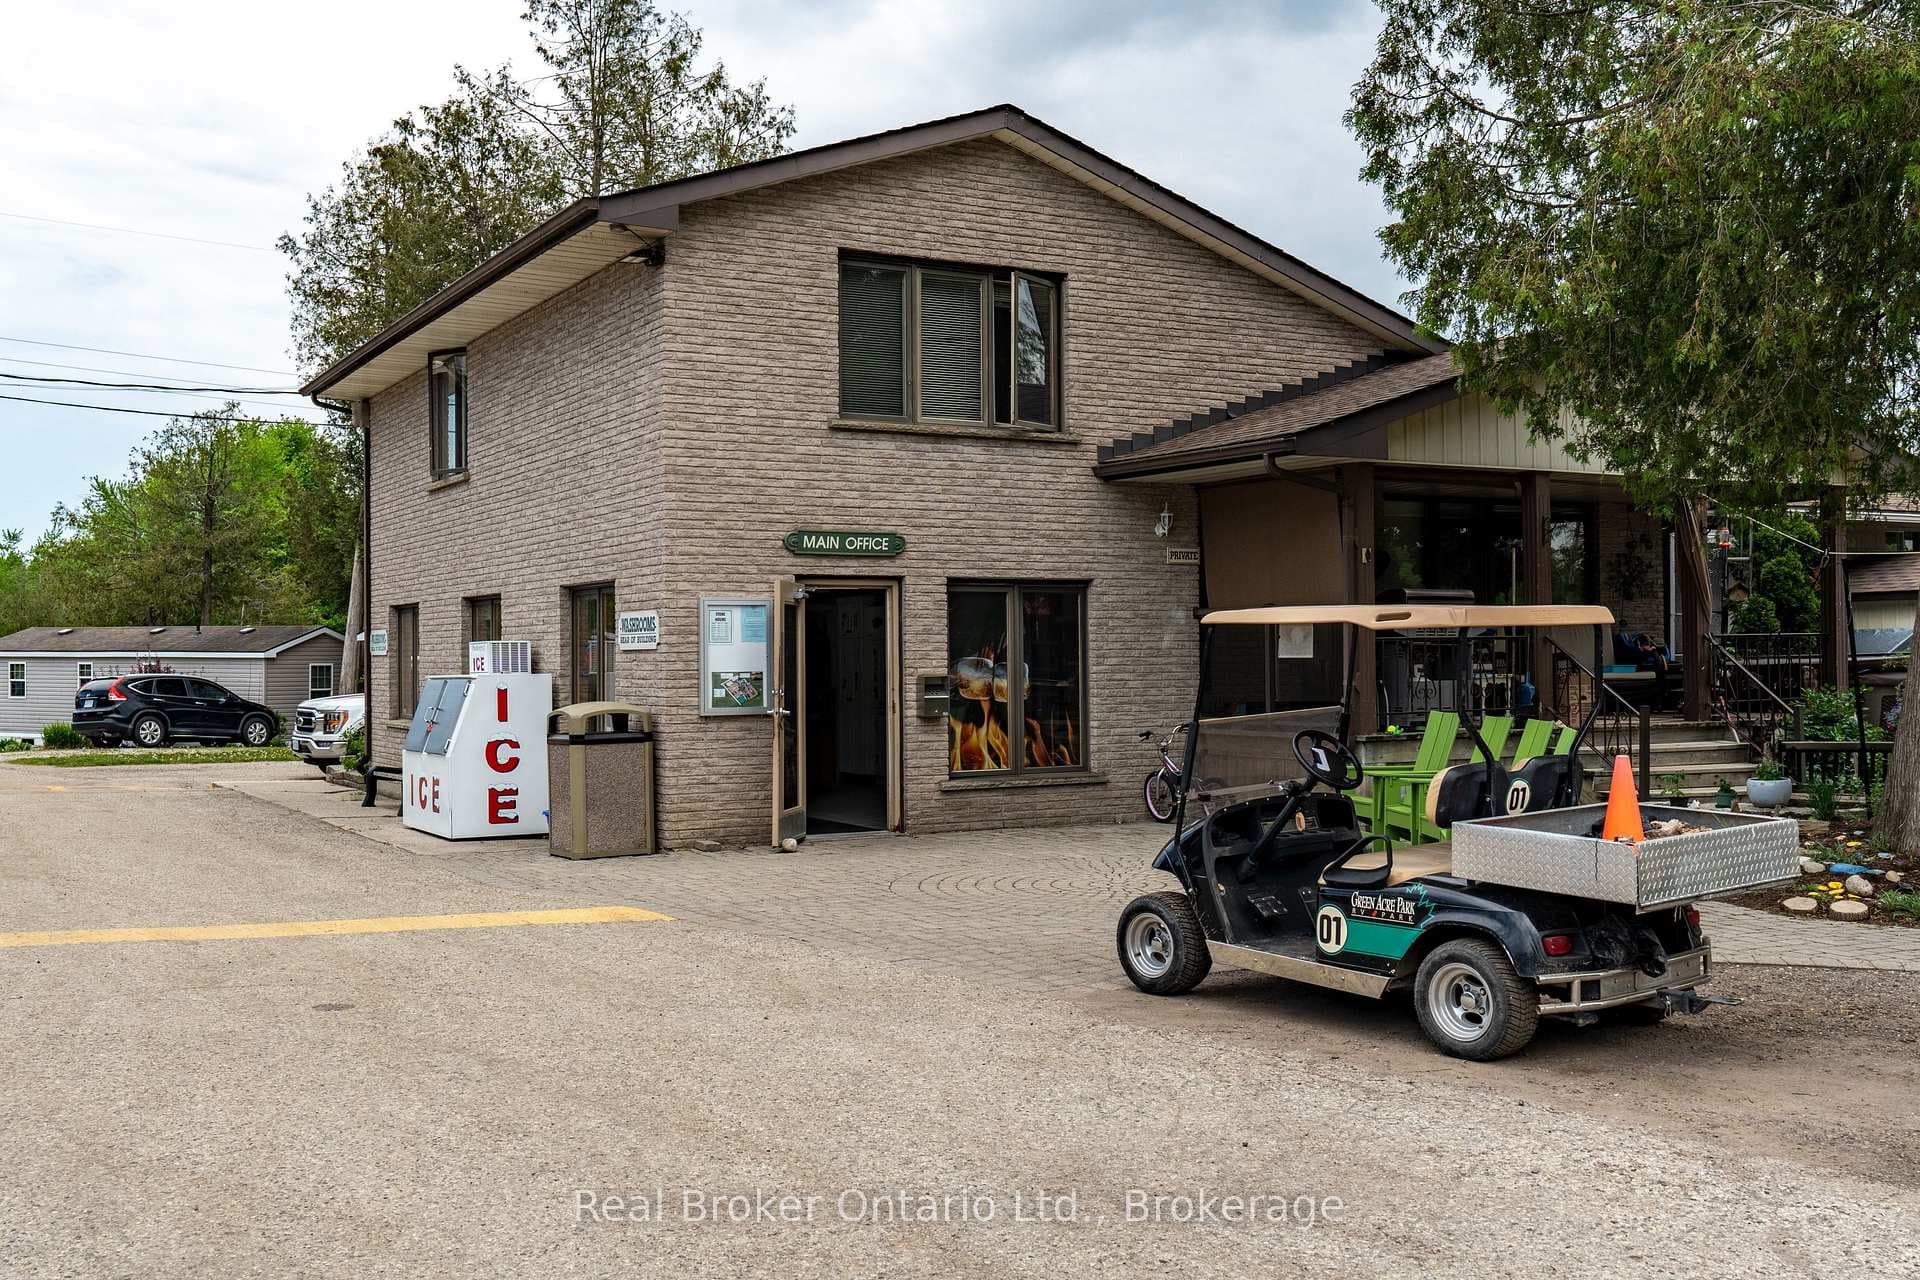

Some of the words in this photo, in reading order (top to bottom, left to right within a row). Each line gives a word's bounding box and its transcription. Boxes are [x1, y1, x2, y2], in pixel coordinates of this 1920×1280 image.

[802, 535, 840, 550] MAIN
[845, 536, 889, 551] OFFICE
[1170, 550, 1199, 560] PRIVATE
[621, 616, 656, 632] WASHROOMS
[473, 656, 485, 672] ICE
[485, 682, 521, 825] ICE
[409, 774, 440, 814] ICE
[1509, 786, 1527, 811] 01
[1319, 914, 1342, 946] 01
